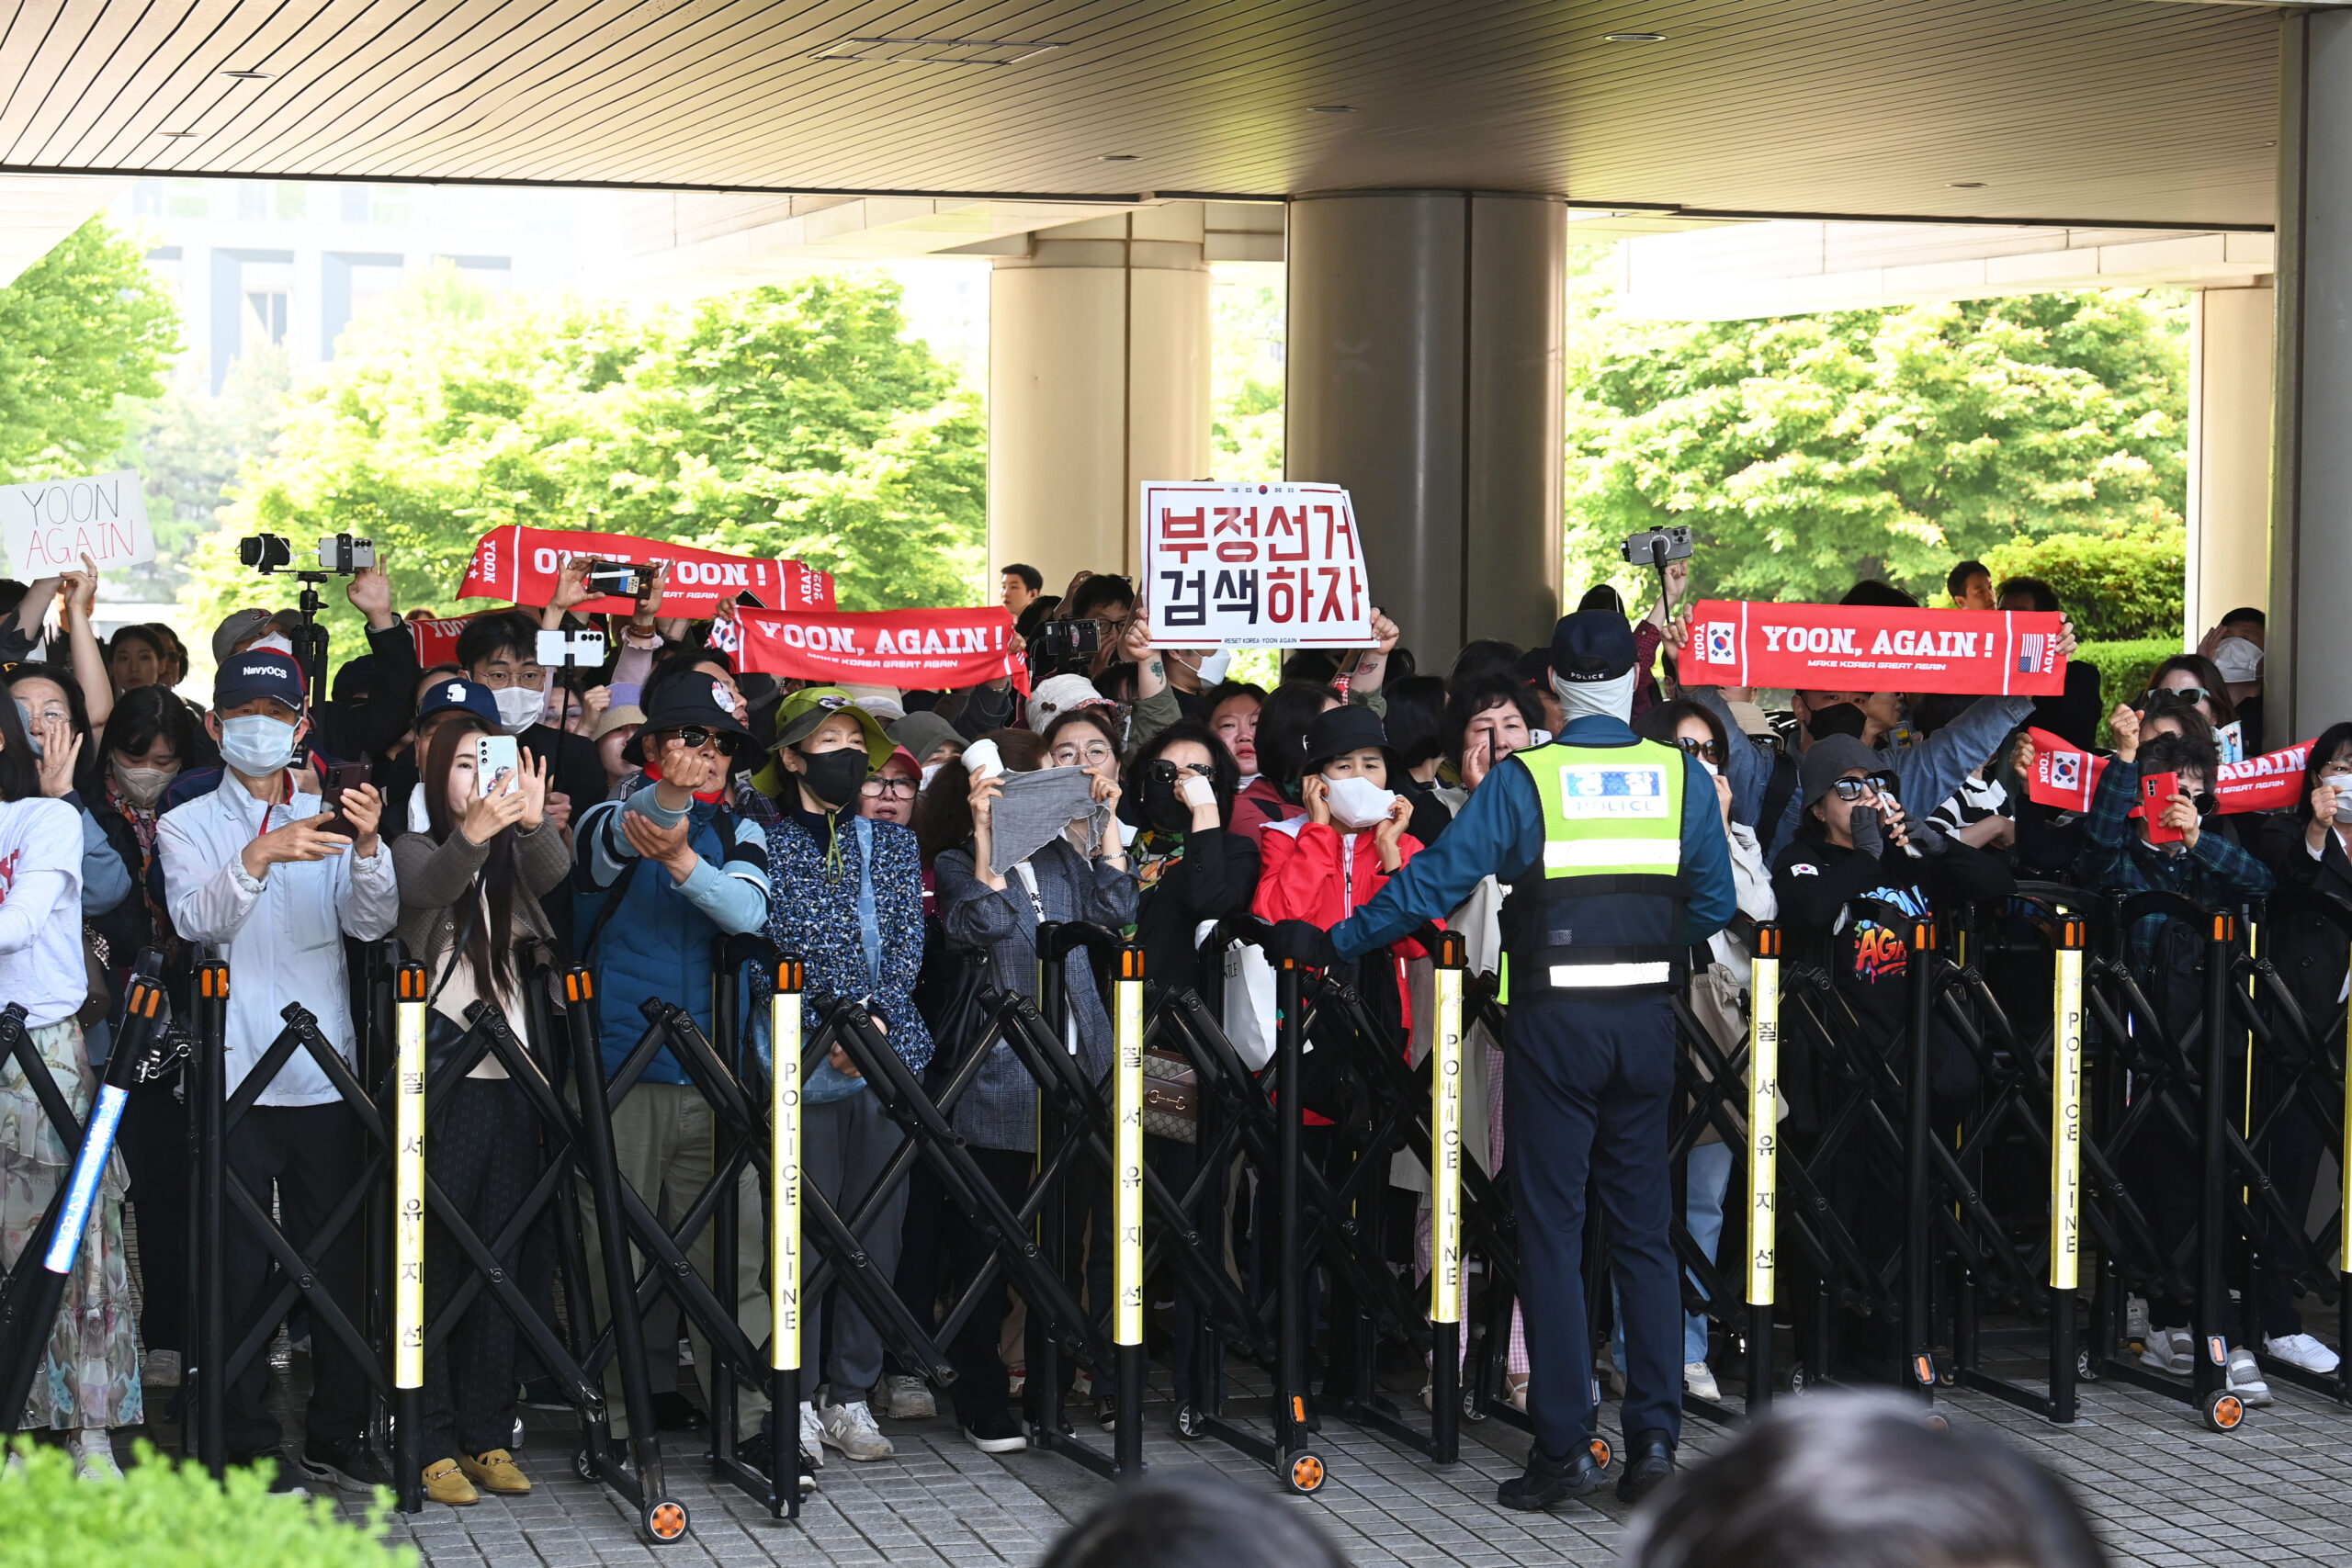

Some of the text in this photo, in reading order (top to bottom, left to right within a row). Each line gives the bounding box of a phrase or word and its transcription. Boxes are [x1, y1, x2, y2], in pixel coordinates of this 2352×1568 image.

[22, 479, 118, 526] YOON
[27, 520, 133, 570] AGAIN
[1159, 505, 1355, 564] 부정선거
[483, 540, 496, 583] YOON
[797, 563, 813, 604] AGA
[812, 570, 824, 601] 202
[1160, 566, 1362, 626] 검색하자
[424, 620, 471, 637] YOO
[755, 619, 865, 656] YOON,
[874, 626, 988, 655] AGAIN
[1694, 624, 1705, 661] YOON
[1761, 626, 1863, 656] YOON,
[1871, 629, 1976, 658] AGAIN
[243, 666, 288, 679] NavyOCS
[807, 652, 958, 669] MAKE KOREA GREAT AGAIN
[1839, 660, 1875, 669] KOREA
[1877, 661, 1912, 670] GREAT
[1914, 662, 1946, 671] AGAIN
[2042, 633, 2056, 674] AGAIN
[2040, 751, 2051, 784] YOON
[2217, 747, 2307, 781] AGAIN
[1577, 801, 1652, 812] POLICE
[2222, 784, 2254, 794] GREAT
[2255, 780, 2285, 789] AGAIN
[1856, 927, 1906, 970] AGA
[1755, 1021, 1777, 1269] 질서유지선
[2065, 1012, 2080, 1253] POLICE LINE
[1443, 1034, 1459, 1286] POLICE LINE
[401, 1071, 424, 1348] 질서유지선
[782, 1062, 798, 1330] POLICE LINE
